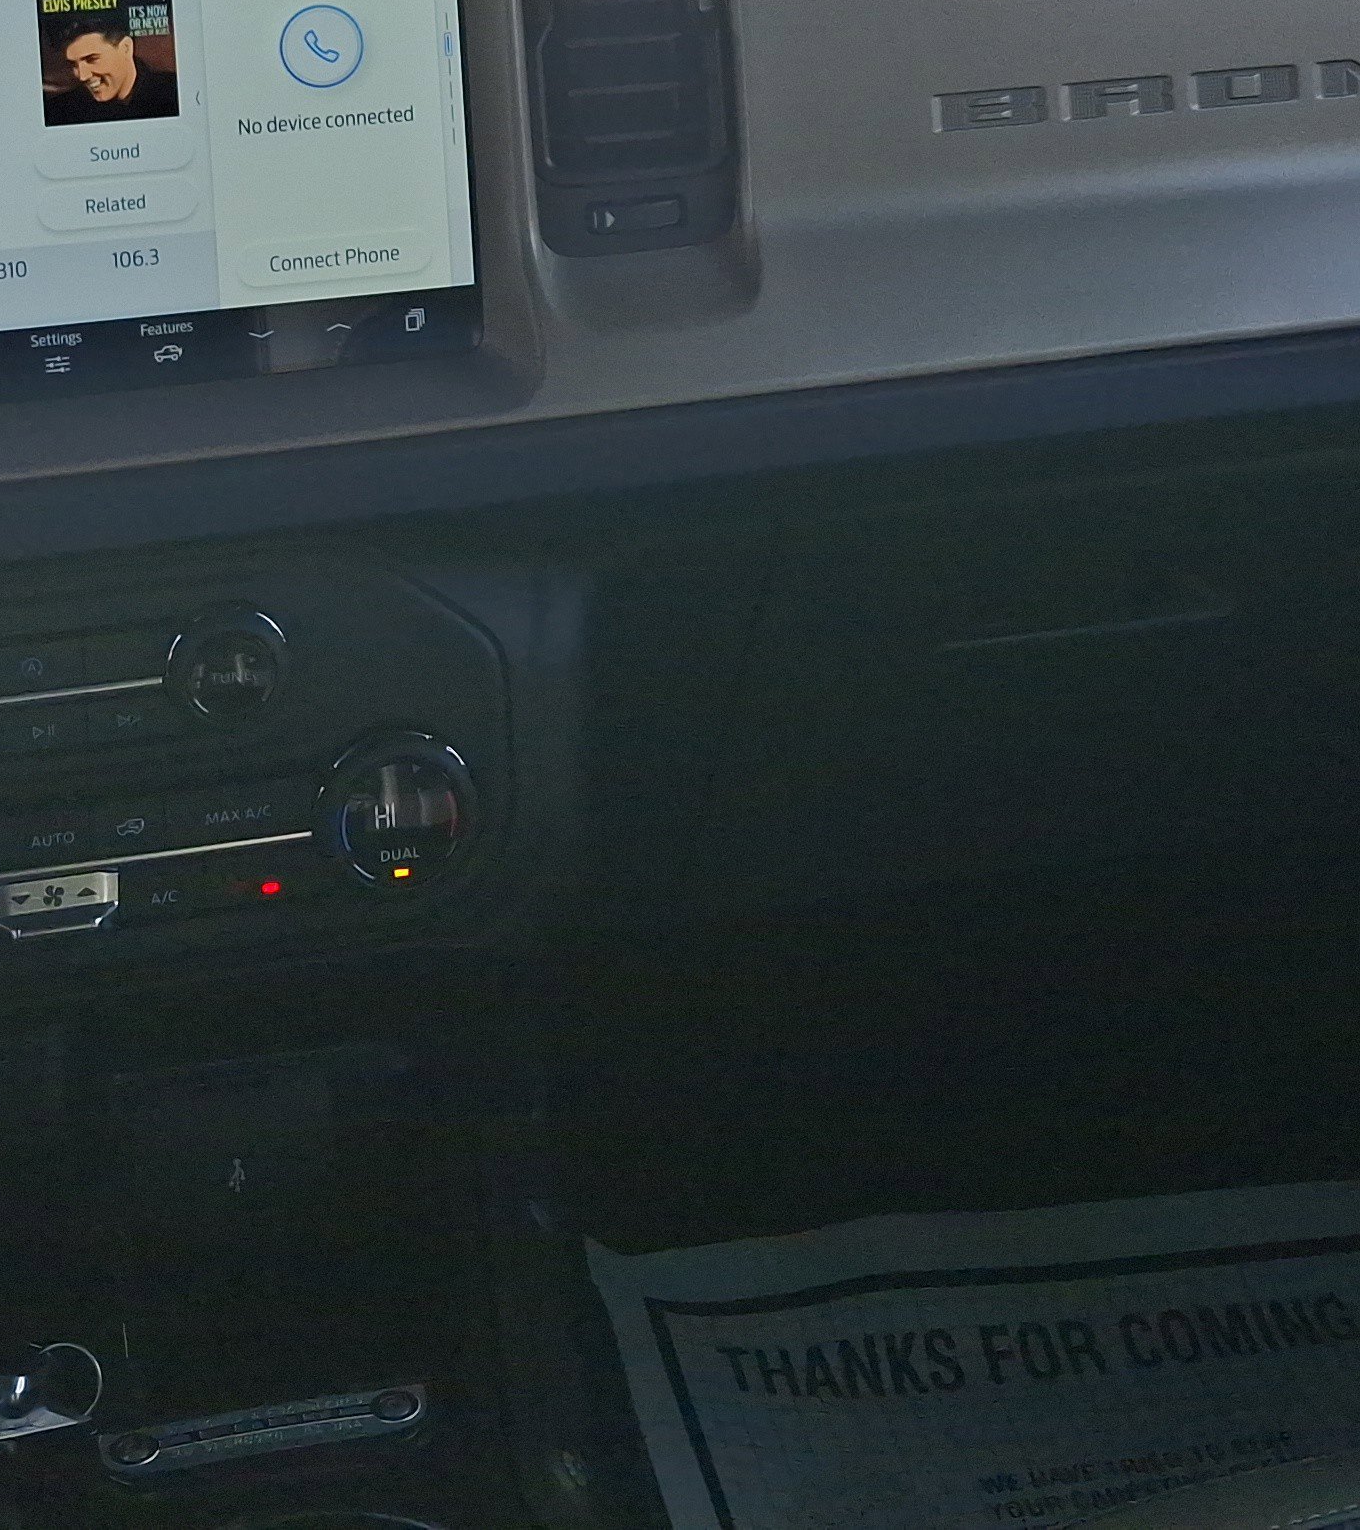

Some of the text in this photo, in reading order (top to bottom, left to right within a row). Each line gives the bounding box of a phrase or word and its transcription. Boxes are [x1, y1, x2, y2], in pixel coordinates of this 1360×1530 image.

[147, 5, 168, 17] NOW
[129, 17, 169, 29] OR NEVER
[238, 106, 414, 135] No device connected
[89, 143, 140, 162] Sound
[84, 194, 146, 214] Related
[111, 248, 160, 269] 106.3
[269, 244, 400, 273] Connect Phone
[140, 319, 193, 336] Features
[30, 329, 82, 349] Settings
[205, 804, 272, 826] MAX A/C
[374, 804, 398, 830] HI
[30, 830, 76, 849] AUTO
[379, 845, 421, 863] DUAL
[151, 889, 179, 906] A/C
[717, 1325, 965, 1402] THANKS
[980, 1316, 1108, 1385] FOR
[978, 1473, 1018, 1494] WE
[1027, 1461, 1096, 1489] HAVE
[990, 1494, 1064, 1521] YOUR
